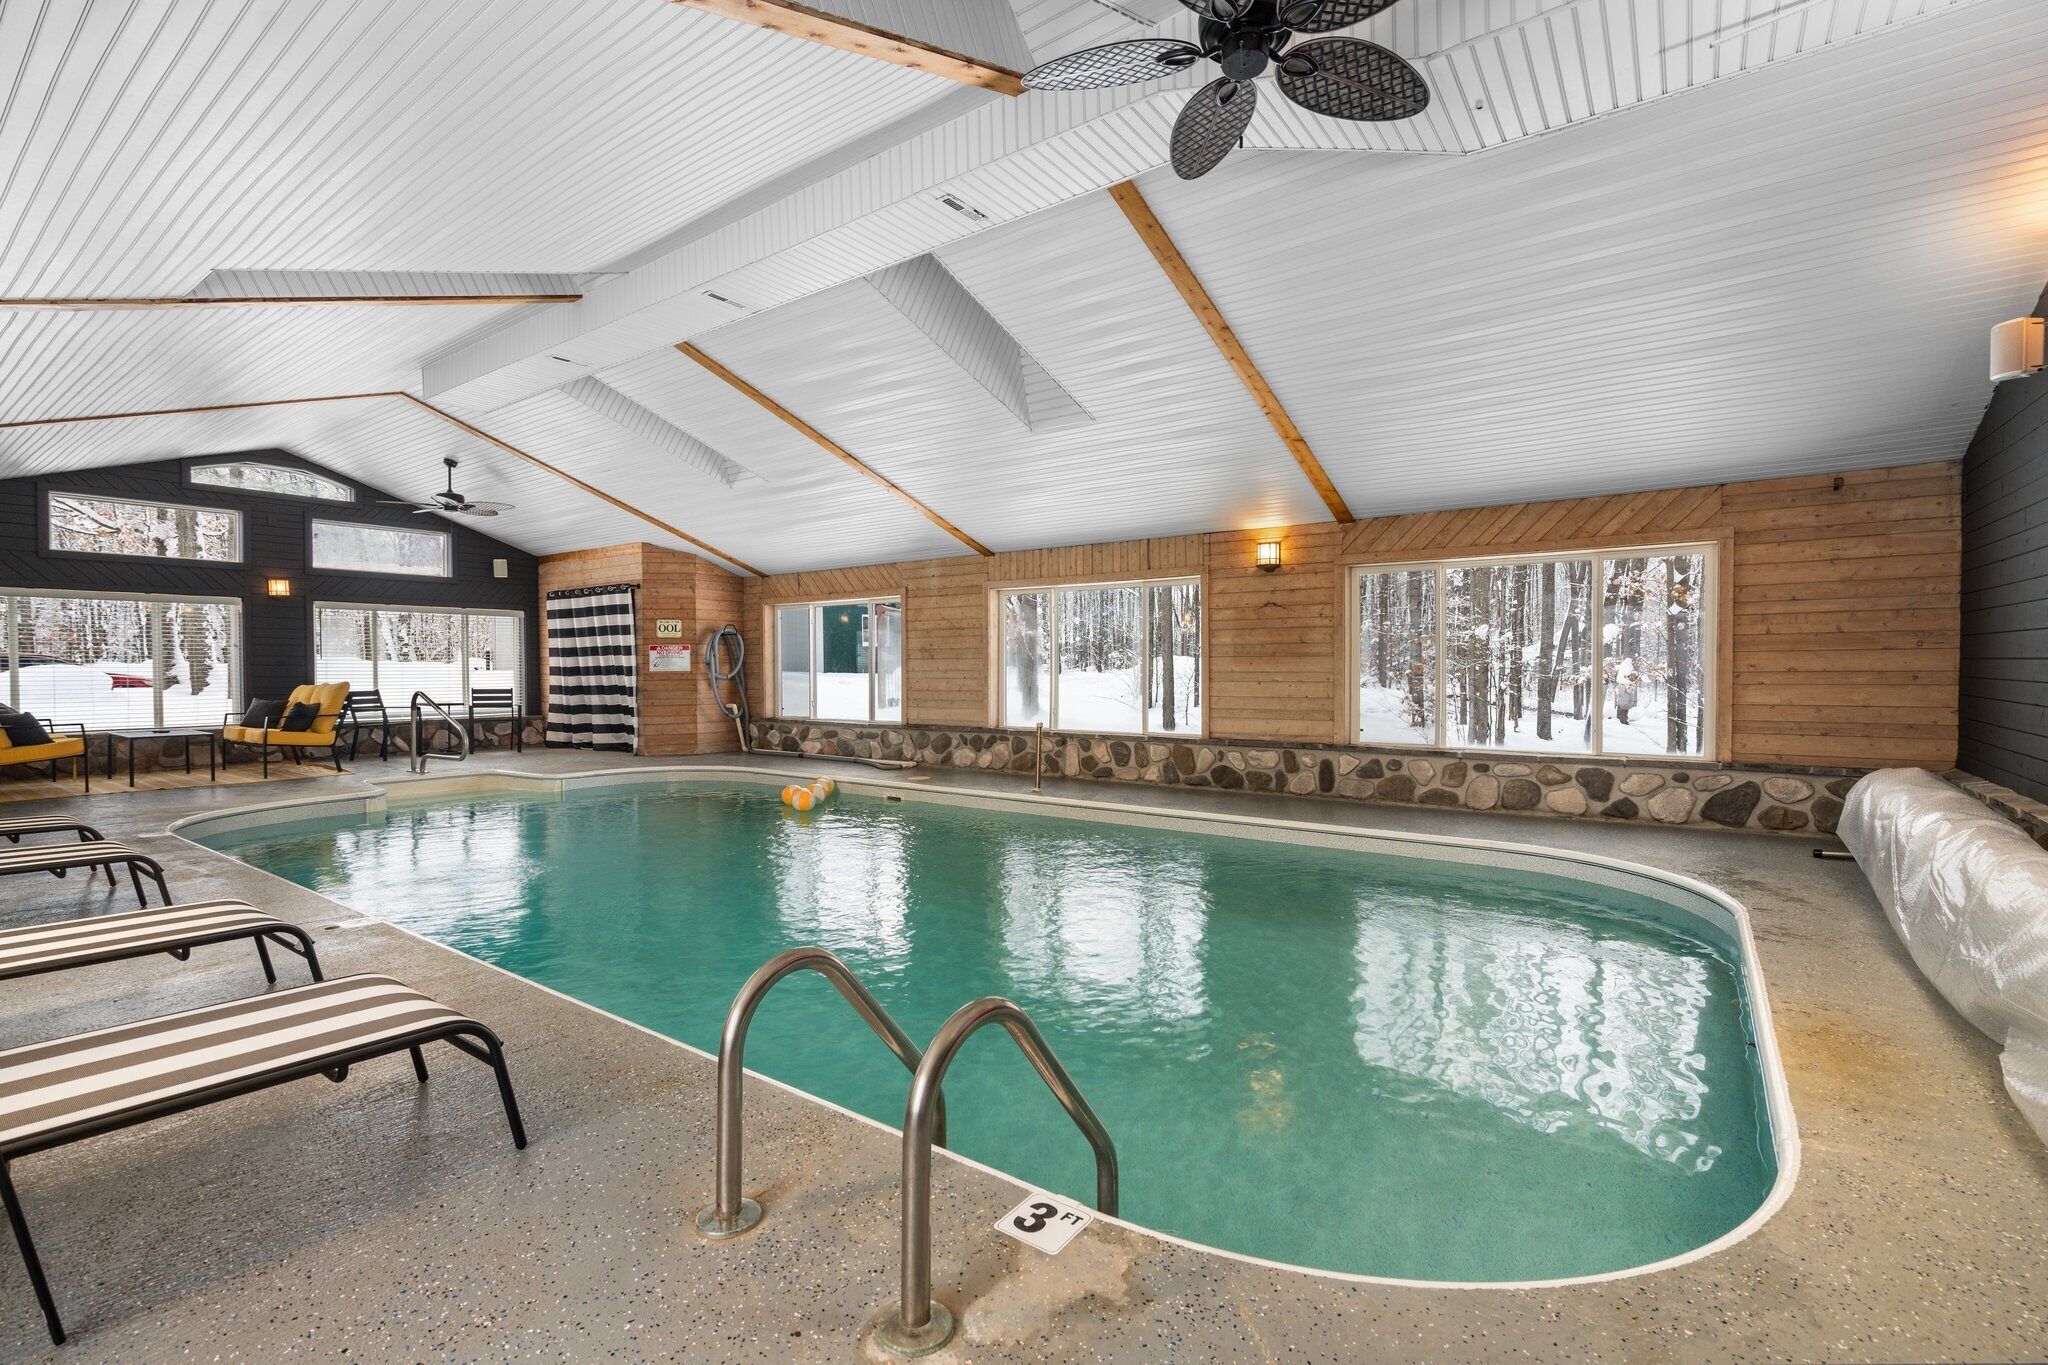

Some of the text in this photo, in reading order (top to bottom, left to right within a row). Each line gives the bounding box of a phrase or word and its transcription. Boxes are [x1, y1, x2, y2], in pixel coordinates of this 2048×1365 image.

[658, 623, 681, 633] OOL
[1013, 1202, 1084, 1233] 3 FT
